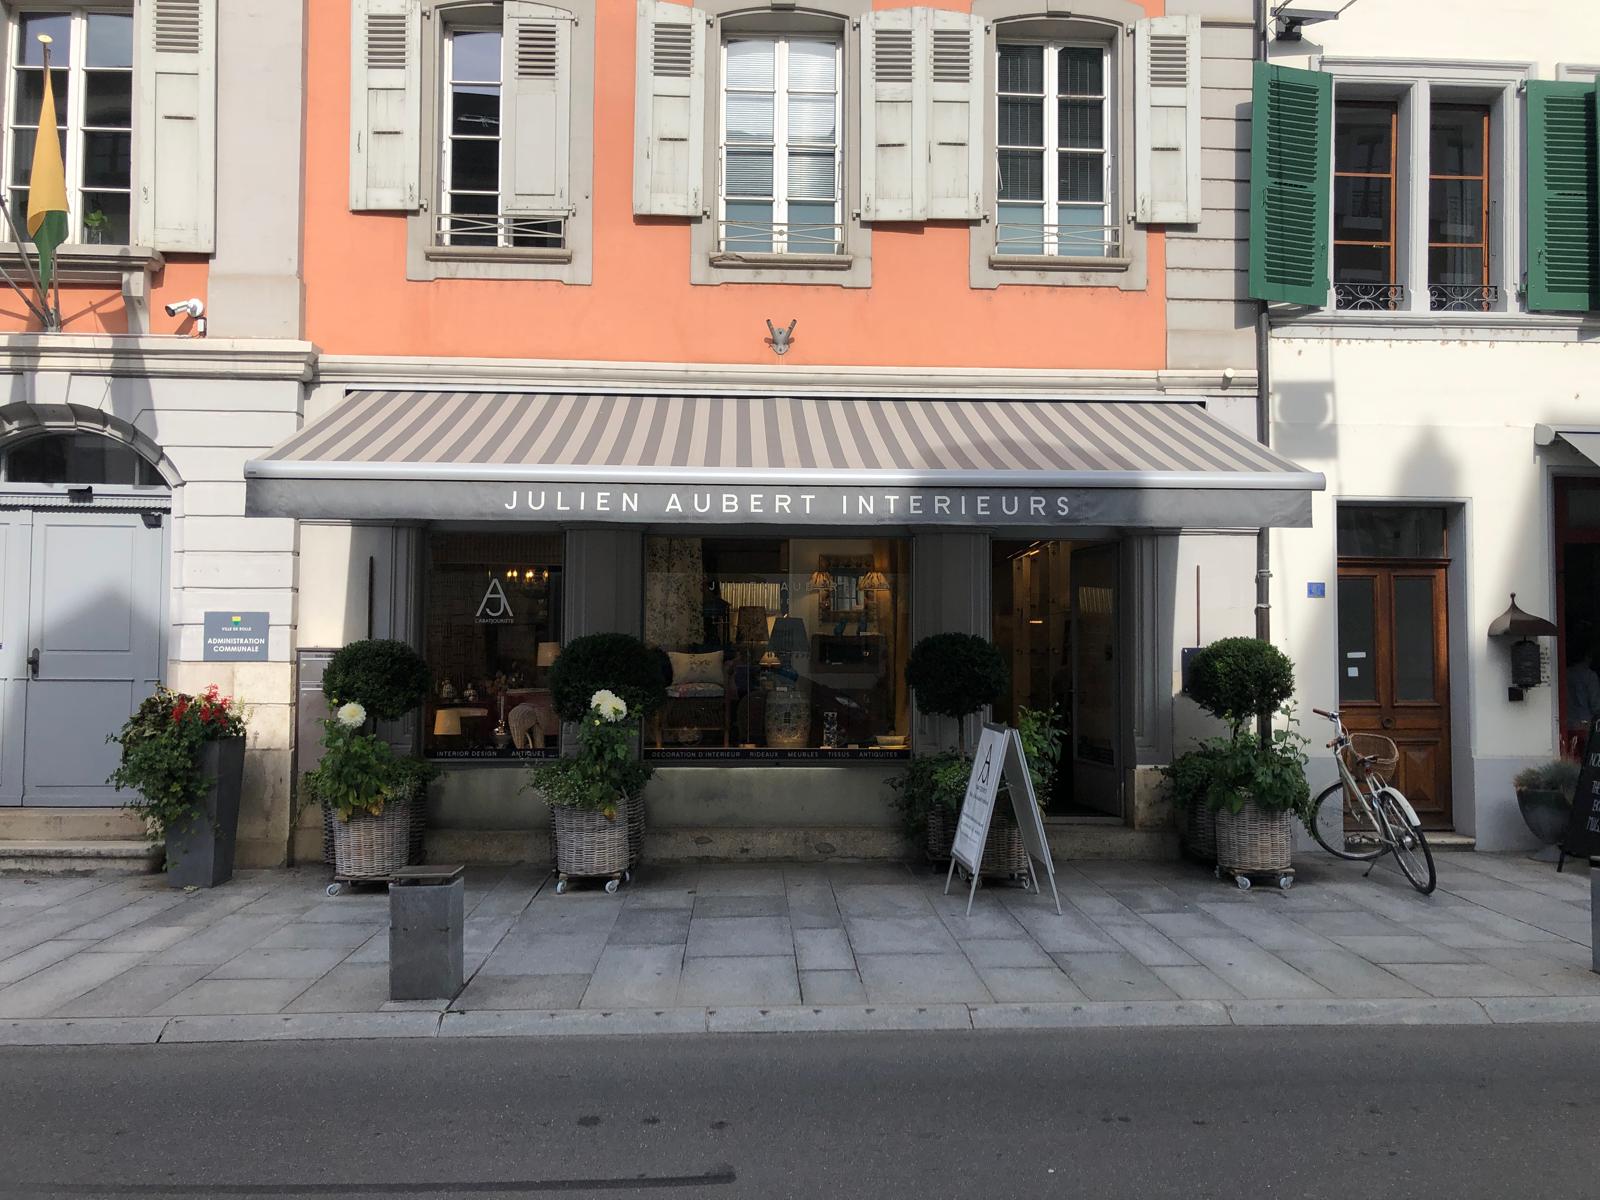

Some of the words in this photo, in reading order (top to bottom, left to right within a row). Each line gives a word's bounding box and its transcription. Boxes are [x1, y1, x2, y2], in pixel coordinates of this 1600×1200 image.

[504, 490, 639, 512] JULIEN
[665, 493, 816, 514] AUBERT
[842, 495, 1069, 516] INTERIEURS
[511, 750, 545, 758] ANTIQUES
